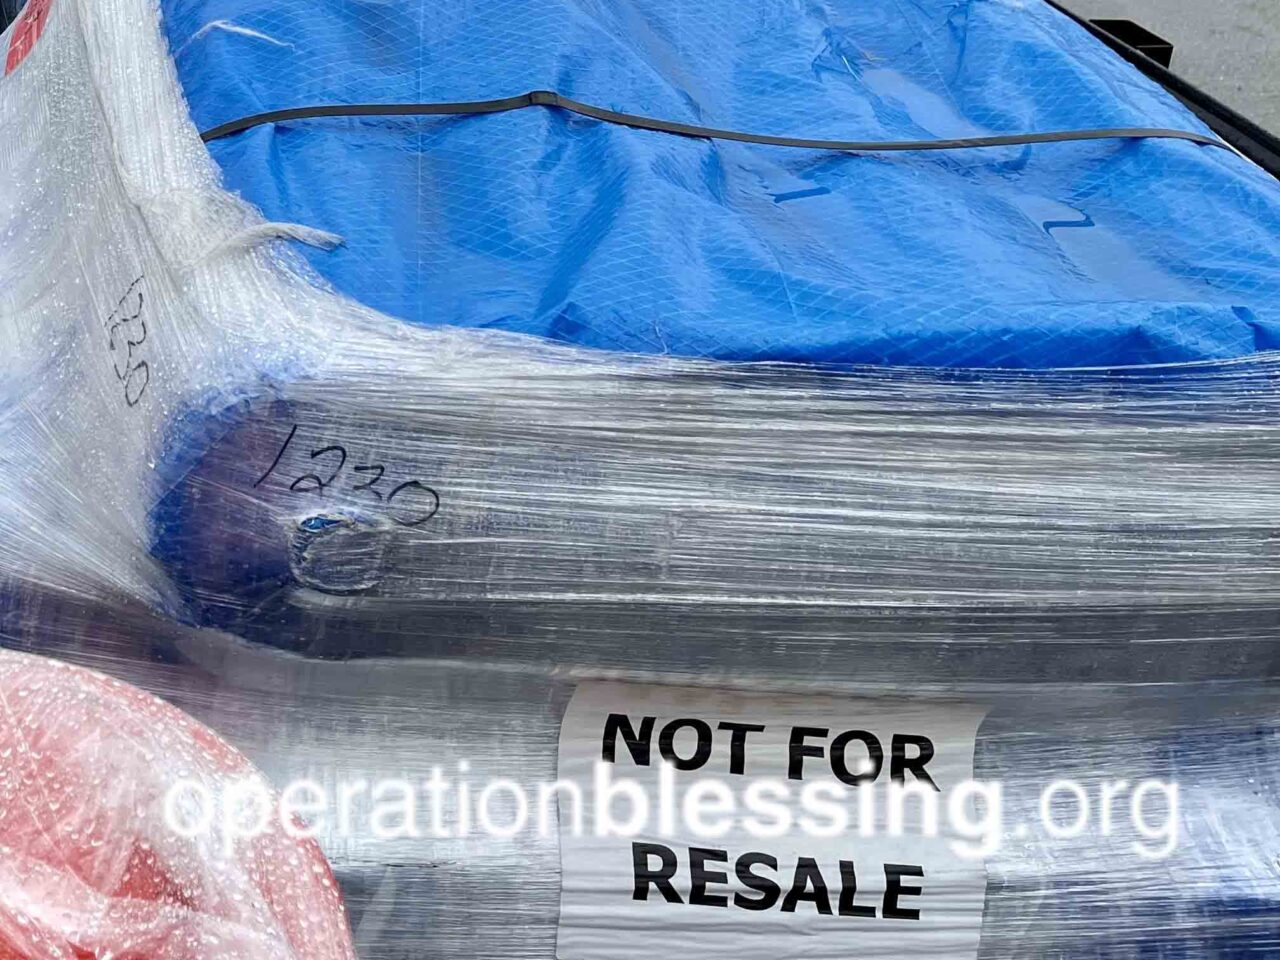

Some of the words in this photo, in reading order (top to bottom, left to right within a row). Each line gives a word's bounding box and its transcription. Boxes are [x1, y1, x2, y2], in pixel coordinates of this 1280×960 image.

[253, 423, 440, 527] 1230
[601, 712, 766, 776] NOT
[786, 725, 942, 794] FOR
[631, 841, 926, 922] RESALE
